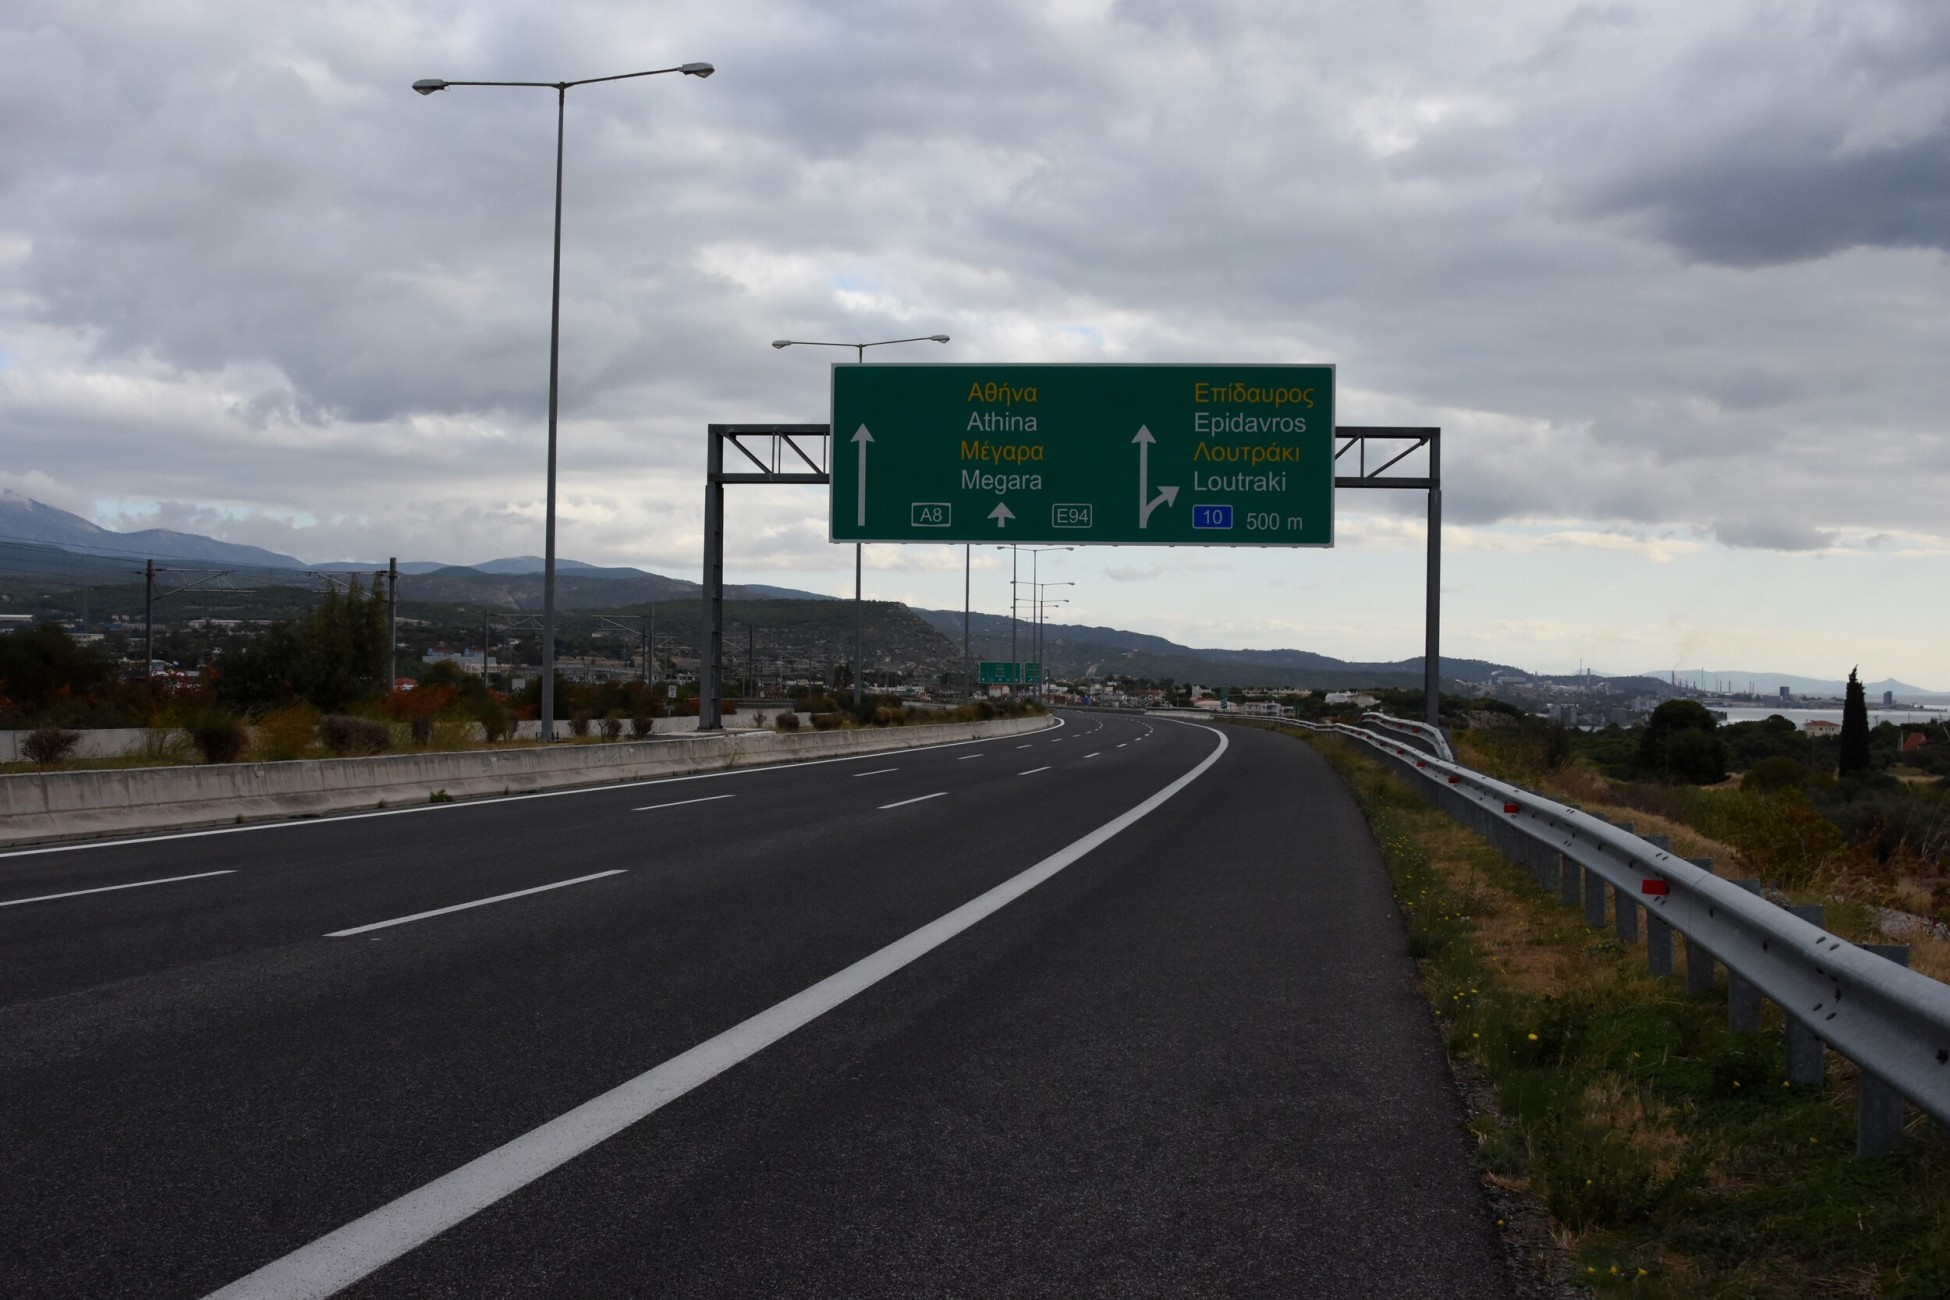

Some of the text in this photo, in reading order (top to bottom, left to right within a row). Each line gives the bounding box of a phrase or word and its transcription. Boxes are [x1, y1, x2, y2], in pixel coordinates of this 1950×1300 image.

[968, 382, 1038, 407] Αθήνα
[1195, 383, 1315, 408] Επίδαυρος
[967, 411, 1038, 432] Athina
[1195, 412, 1307, 437] Epidavros
[961, 440, 1044, 465] Μέγαρα
[1193, 441, 1300, 466] Λουτράκι
[962, 470, 1042, 495] Megara
[1195, 470, 1287, 492] Loutraki
[920, 508, 942, 523] A8
[1057, 508, 1089, 524] E94
[1203, 510, 1223, 525] 10
[1246, 512, 1303, 531] 500 m
